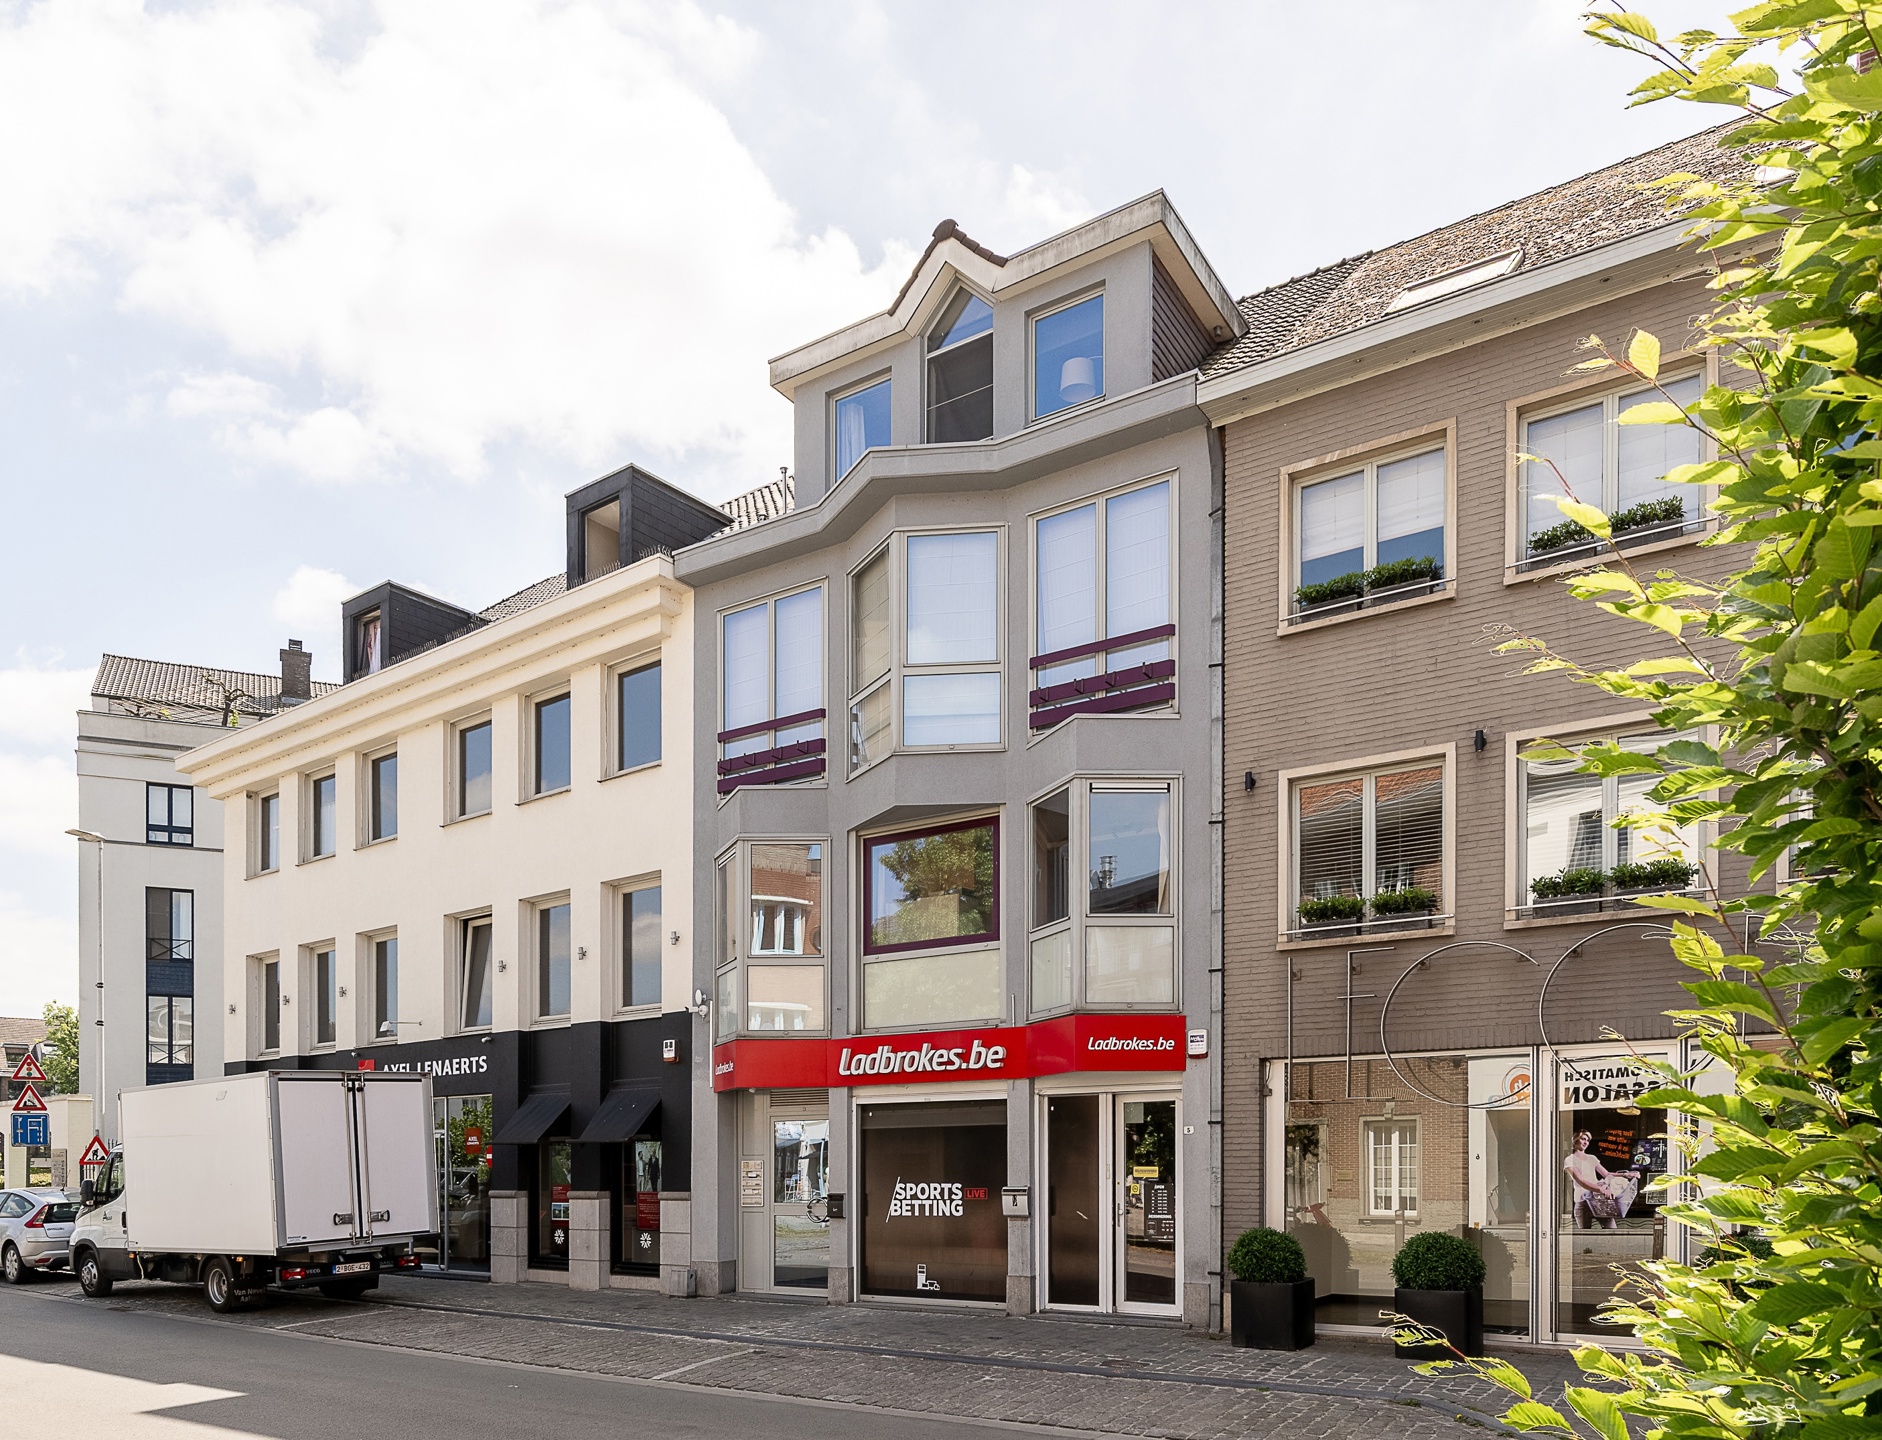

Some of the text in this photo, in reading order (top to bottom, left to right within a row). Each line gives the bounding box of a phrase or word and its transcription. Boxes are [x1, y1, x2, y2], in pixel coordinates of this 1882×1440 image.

[1087, 1036, 1175, 1051] Ladbrokes.be
[417, 1055, 488, 1076] LENAERTS
[838, 1039, 1007, 1076] Ladbrokes.be
[895, 1183, 963, 1200] SPORTS
[966, 1189, 986, 1198] LIVE
[890, 1200, 964, 1217] BETTING
